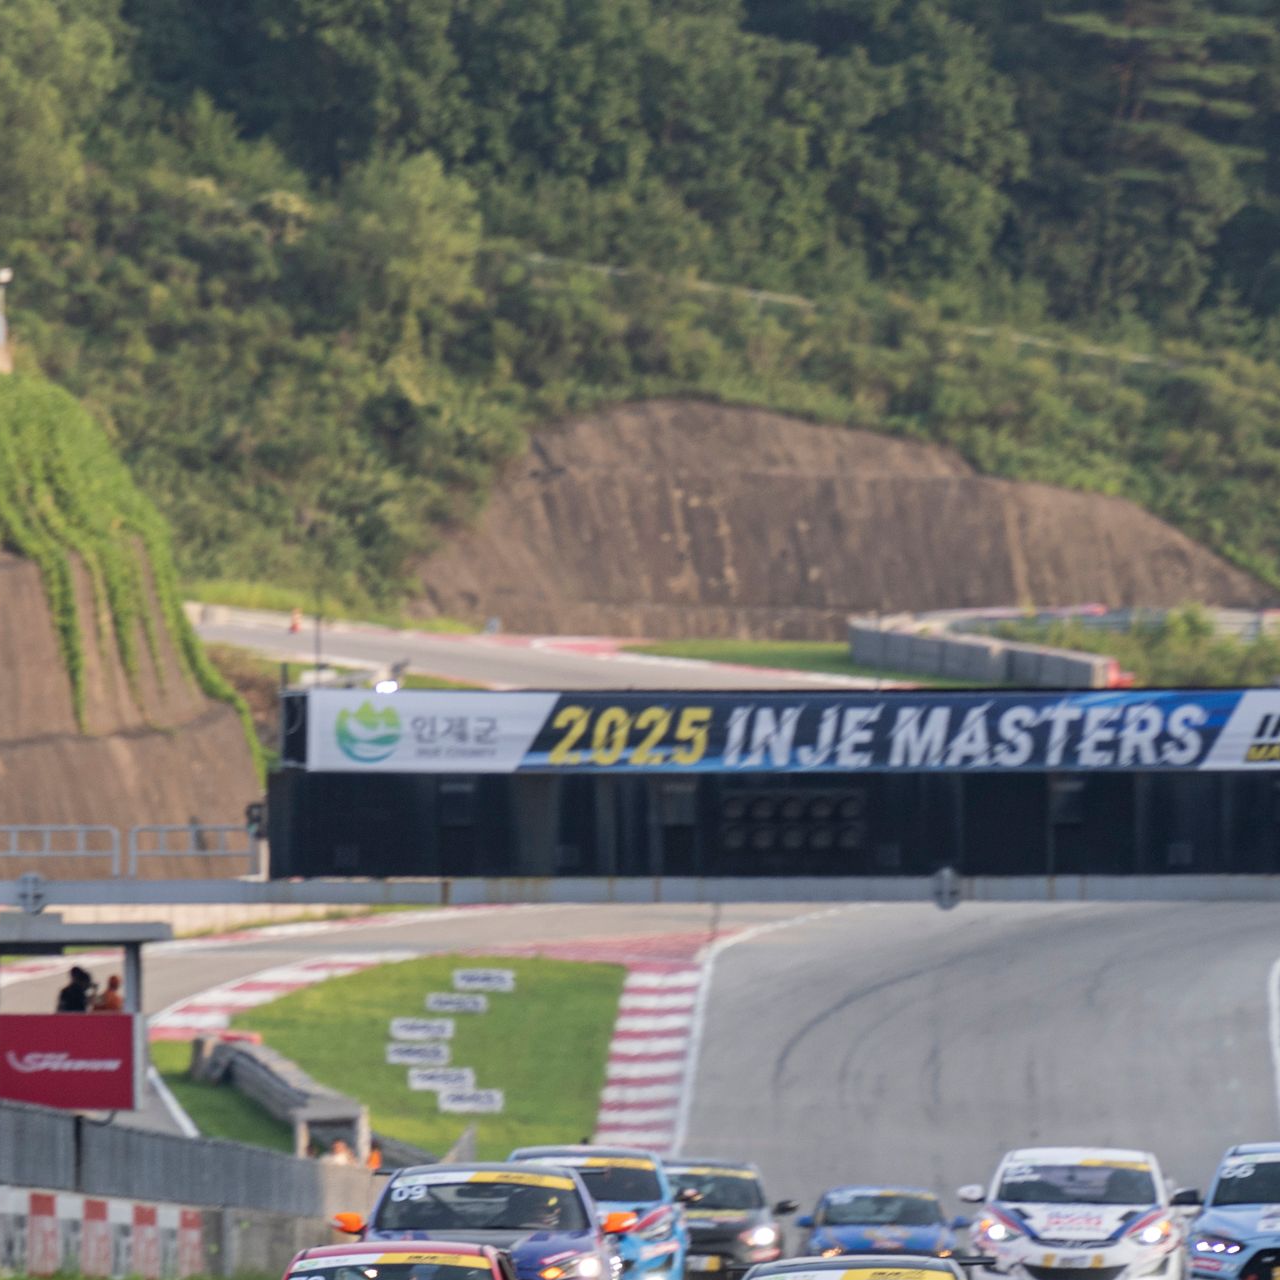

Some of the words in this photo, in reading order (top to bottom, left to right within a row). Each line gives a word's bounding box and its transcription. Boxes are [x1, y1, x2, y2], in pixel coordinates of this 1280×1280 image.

[410, 715, 498, 745] 인제군
[549, 704, 712, 766] 2025
[724, 704, 883, 768] INJE
[887, 702, 1209, 769] MASTERS
[391, 1185, 428, 1202] 09
